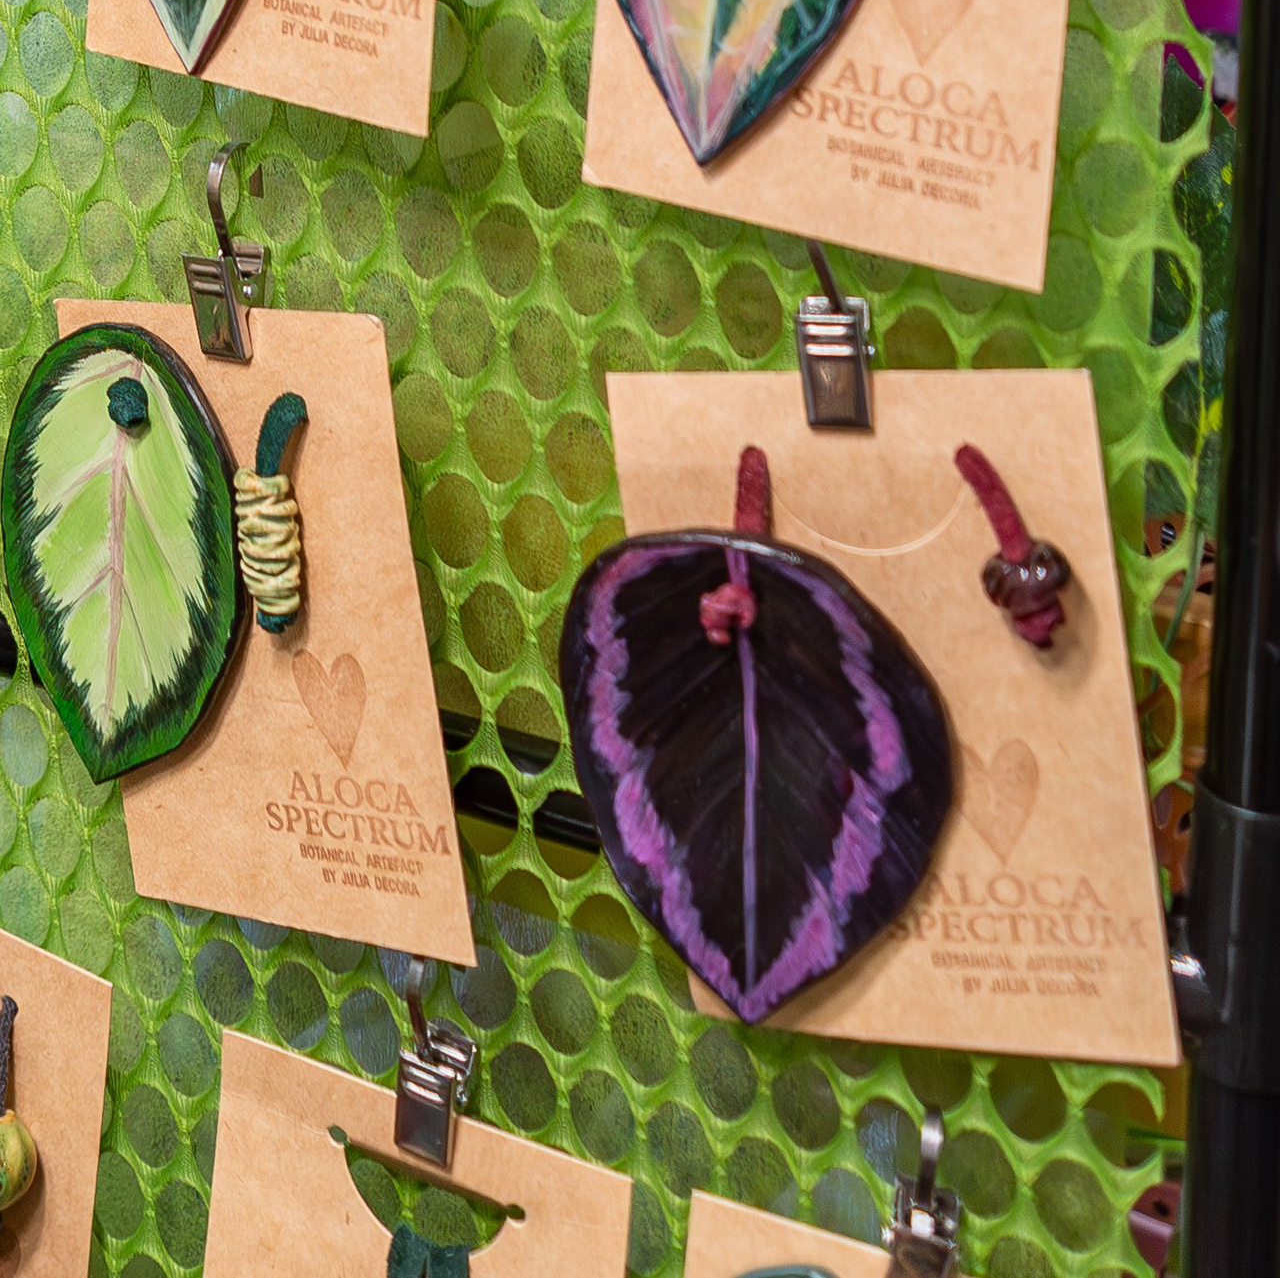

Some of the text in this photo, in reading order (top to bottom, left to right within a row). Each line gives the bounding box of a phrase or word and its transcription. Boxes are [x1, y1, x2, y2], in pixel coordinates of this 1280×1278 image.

[281, 20, 295, 37] BY
[300, 24, 329, 43] JULIA
[832, 59, 1009, 127] ALOCA
[290, 770, 421, 817] ALOCA
[265, 802, 451, 855] SPECTRUM
[299, 843, 359, 866] BOTANICAL
[323, 869, 336, 883] BY
[341, 872, 370, 888] JULIA
